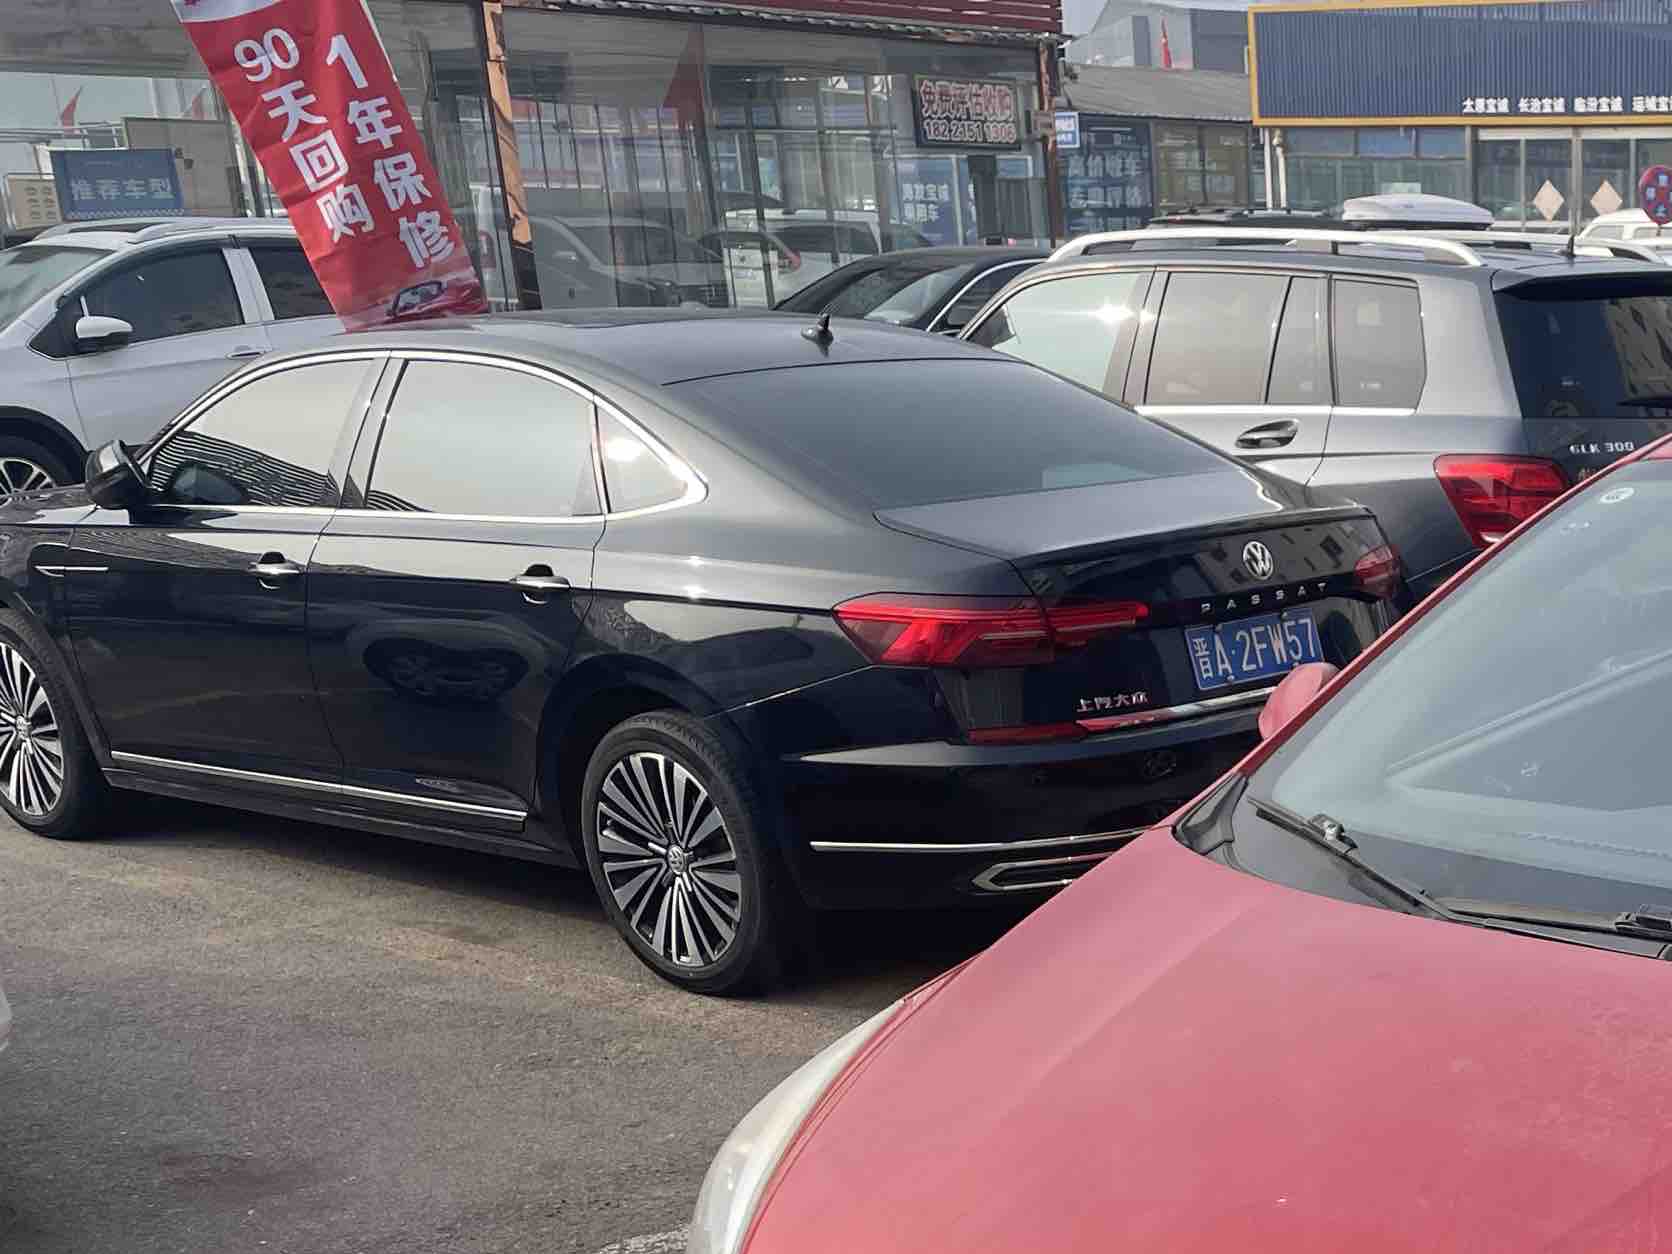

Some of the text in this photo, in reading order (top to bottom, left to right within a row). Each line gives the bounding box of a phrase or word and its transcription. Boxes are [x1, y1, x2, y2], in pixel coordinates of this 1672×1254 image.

[233, 28, 376, 243] 90天回购
[326, 34, 455, 269] 1年保修
[70, 177, 174, 200] 推荐车型
[1604, 441, 1635, 453] 300
[1200, 582, 1327, 613] PASSAT
